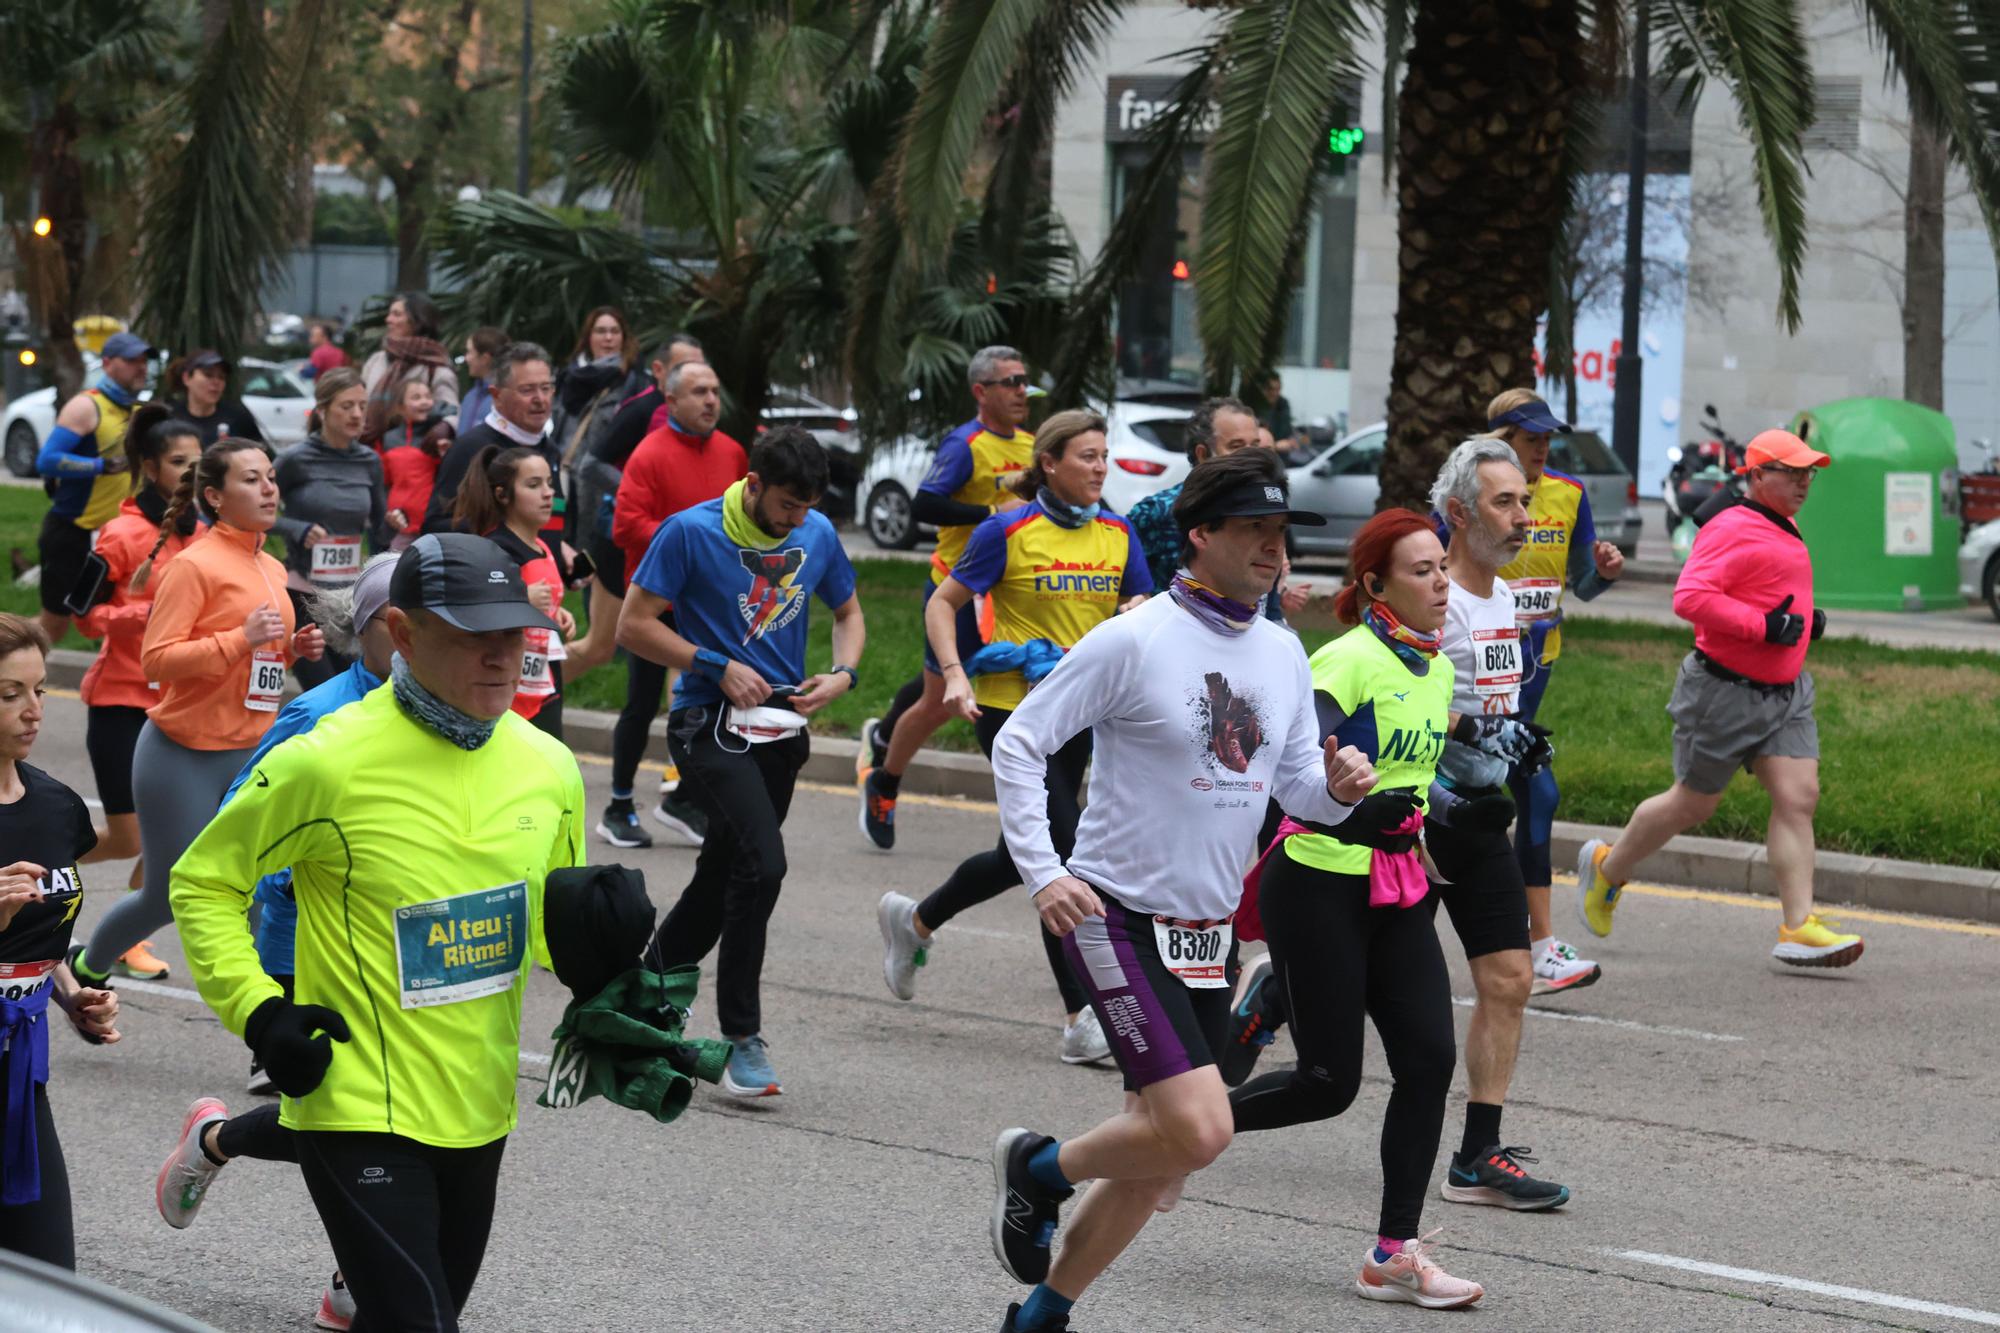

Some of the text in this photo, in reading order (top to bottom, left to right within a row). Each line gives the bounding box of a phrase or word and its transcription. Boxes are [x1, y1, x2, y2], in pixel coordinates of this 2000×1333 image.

[1035, 573, 1120, 593] runners
[1485, 644, 1515, 671] 6824
[460, 917, 501, 940] teu
[443, 941, 506, 968] Ritme
[1168, 929, 1221, 961] 8380
